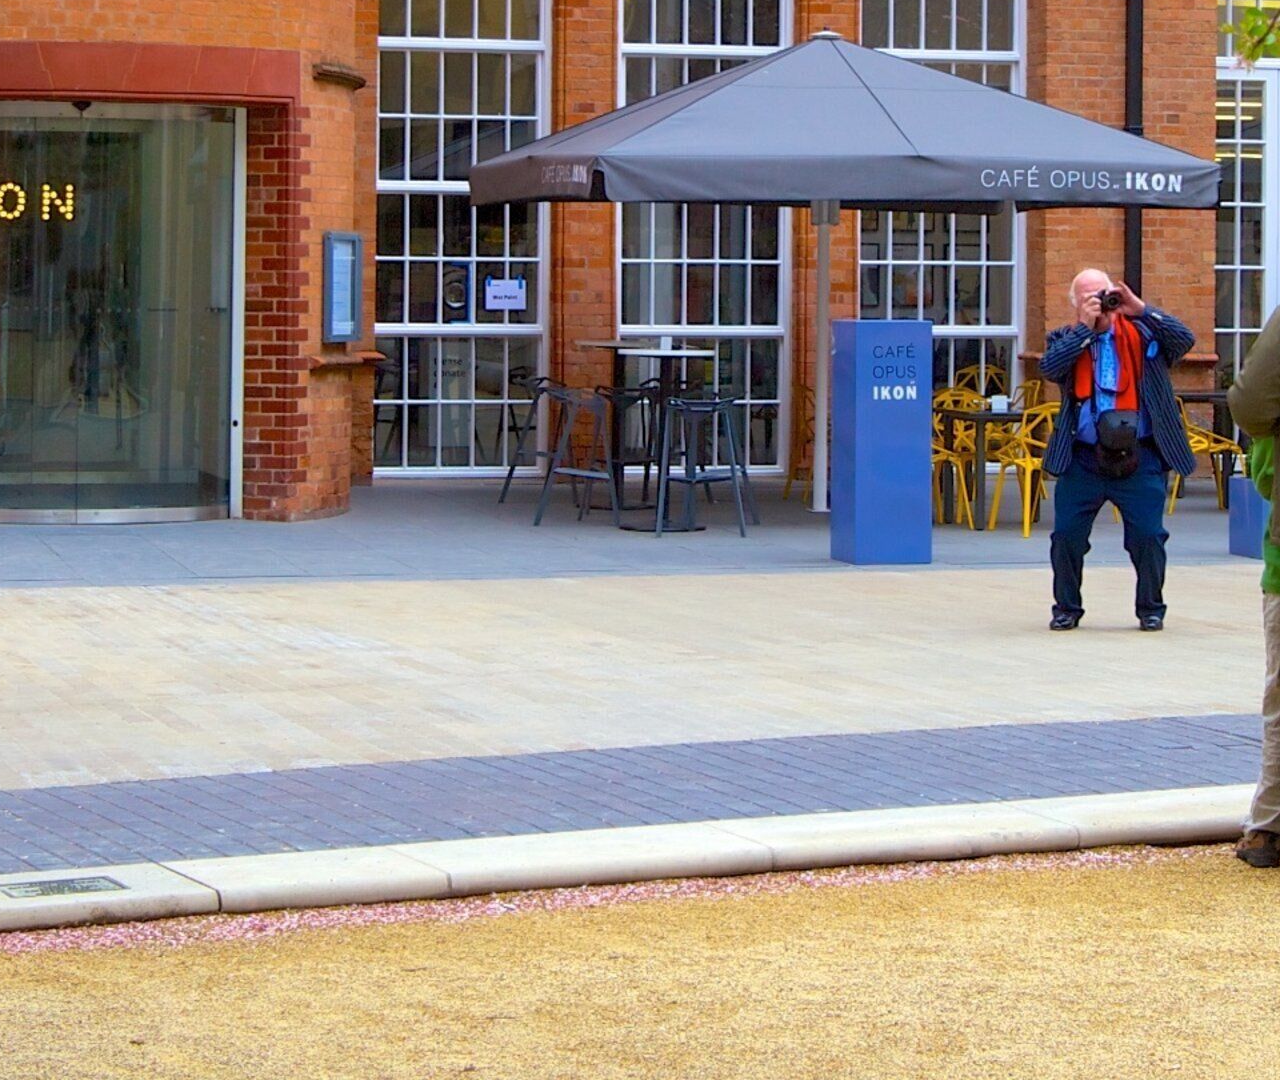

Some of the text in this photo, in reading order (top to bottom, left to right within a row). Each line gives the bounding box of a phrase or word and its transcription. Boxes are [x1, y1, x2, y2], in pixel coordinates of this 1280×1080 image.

[980, 165, 1040, 188] CAFÉ
[1125, 171, 1184, 193] IKON
[872, 342, 916, 359] CAFÉ
[872, 365, 917, 379] OPUS
[873, 385, 917, 401] IKON
